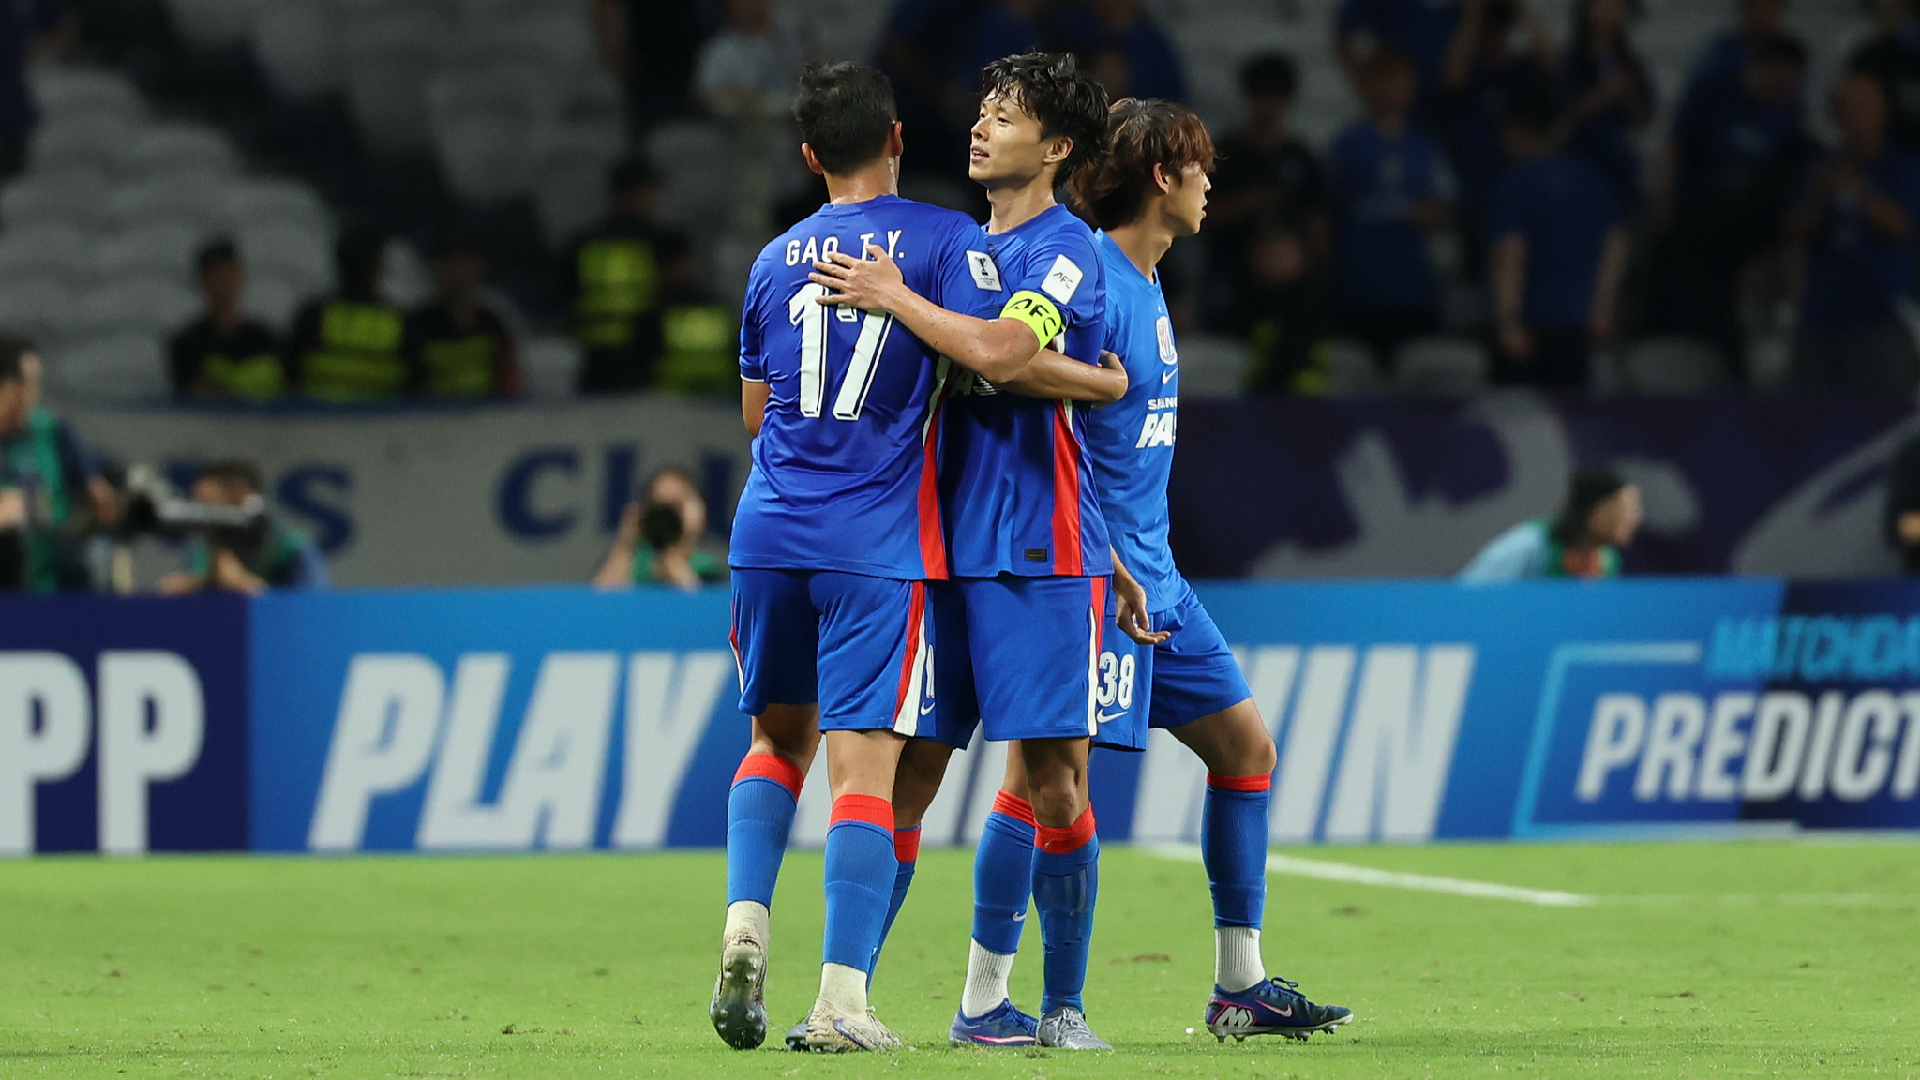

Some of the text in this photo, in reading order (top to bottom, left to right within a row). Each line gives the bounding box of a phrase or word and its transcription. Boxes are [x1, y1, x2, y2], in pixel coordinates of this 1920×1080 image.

[786, 236, 839, 266] GAO
[1053, 272, 1073, 289] AFC
[1006, 298, 1056, 337] AFC
[790, 283, 894, 421] 17
[1135, 412, 1177, 448] PA
[1097, 651, 1135, 709] 38
[308, 652, 732, 850] PLAY
